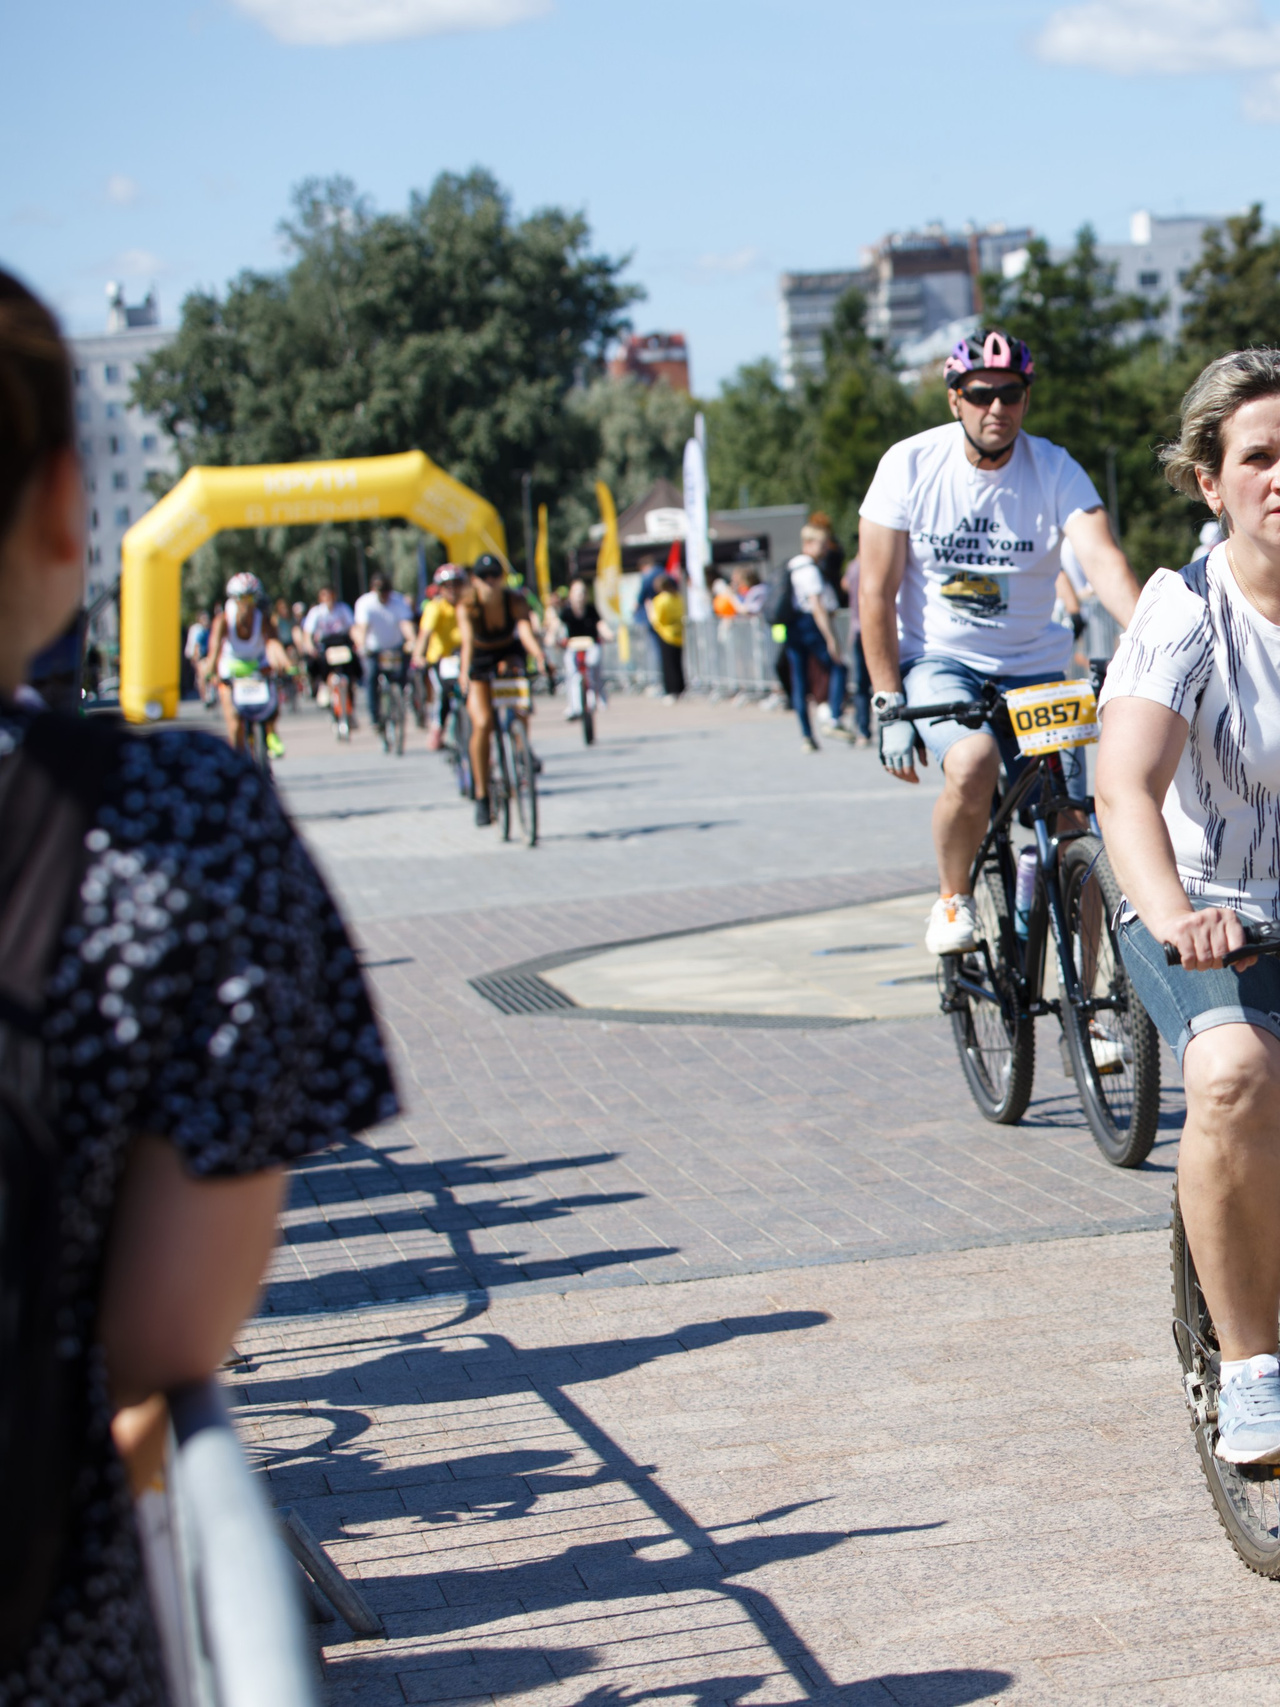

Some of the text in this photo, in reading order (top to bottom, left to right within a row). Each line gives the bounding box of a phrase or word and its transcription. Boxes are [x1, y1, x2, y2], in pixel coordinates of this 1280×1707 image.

[263, 468, 358, 496] КРУТИ
[955, 517, 1000, 533] Alle
[920, 532, 1034, 552] reden vom
[933, 547, 1015, 567] Wetter.
[1015, 701, 1080, 731] 0857
